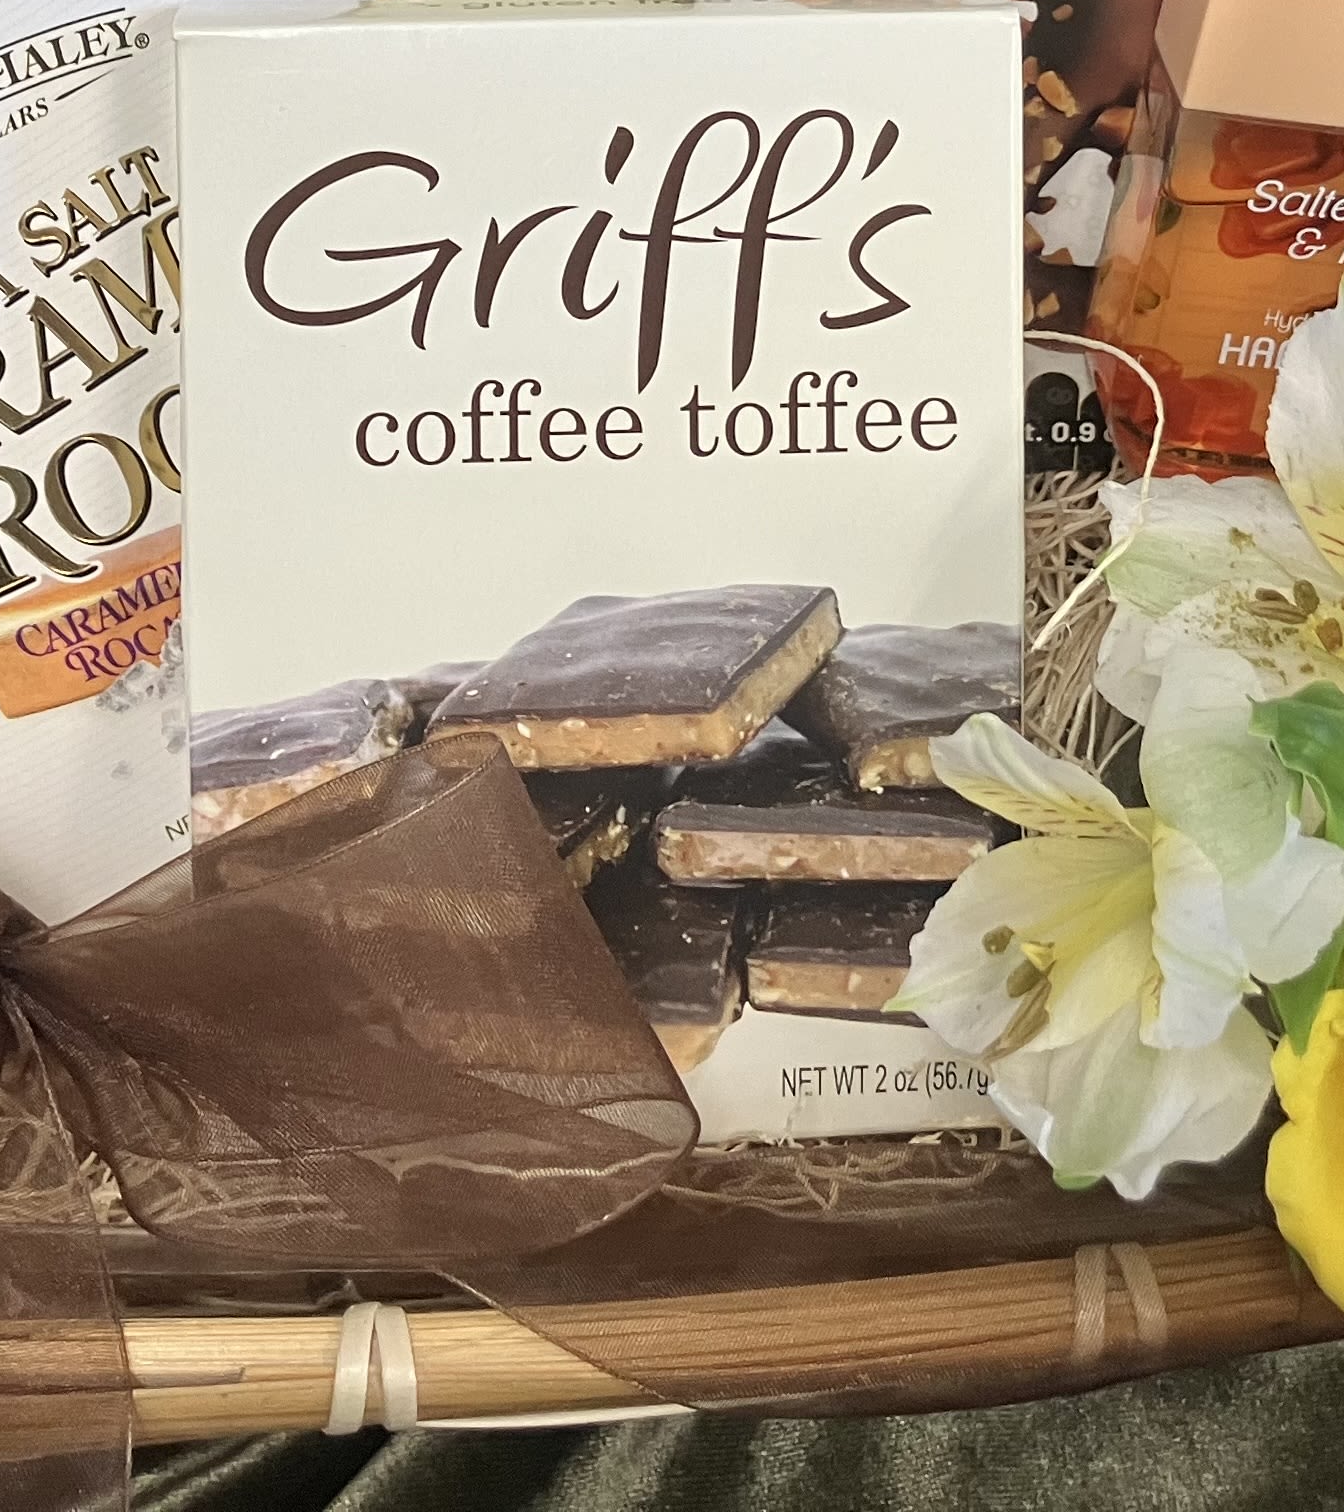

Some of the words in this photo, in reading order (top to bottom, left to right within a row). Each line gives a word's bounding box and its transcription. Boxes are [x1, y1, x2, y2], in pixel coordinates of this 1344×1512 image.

[18, 145, 173, 277] SALT
[244, 108, 933, 394] Griff's
[1288, 227, 1327, 260] &
[355, 379, 644, 467] coffee
[681, 371, 959, 457] toffee
[1050, 420, 1097, 443] 0.9
[782, 1066, 827, 1097] NET
[833, 1064, 869, 1095] WT
[875, 1064, 887, 1093] 2
[894, 1070, 919, 1092] oz
